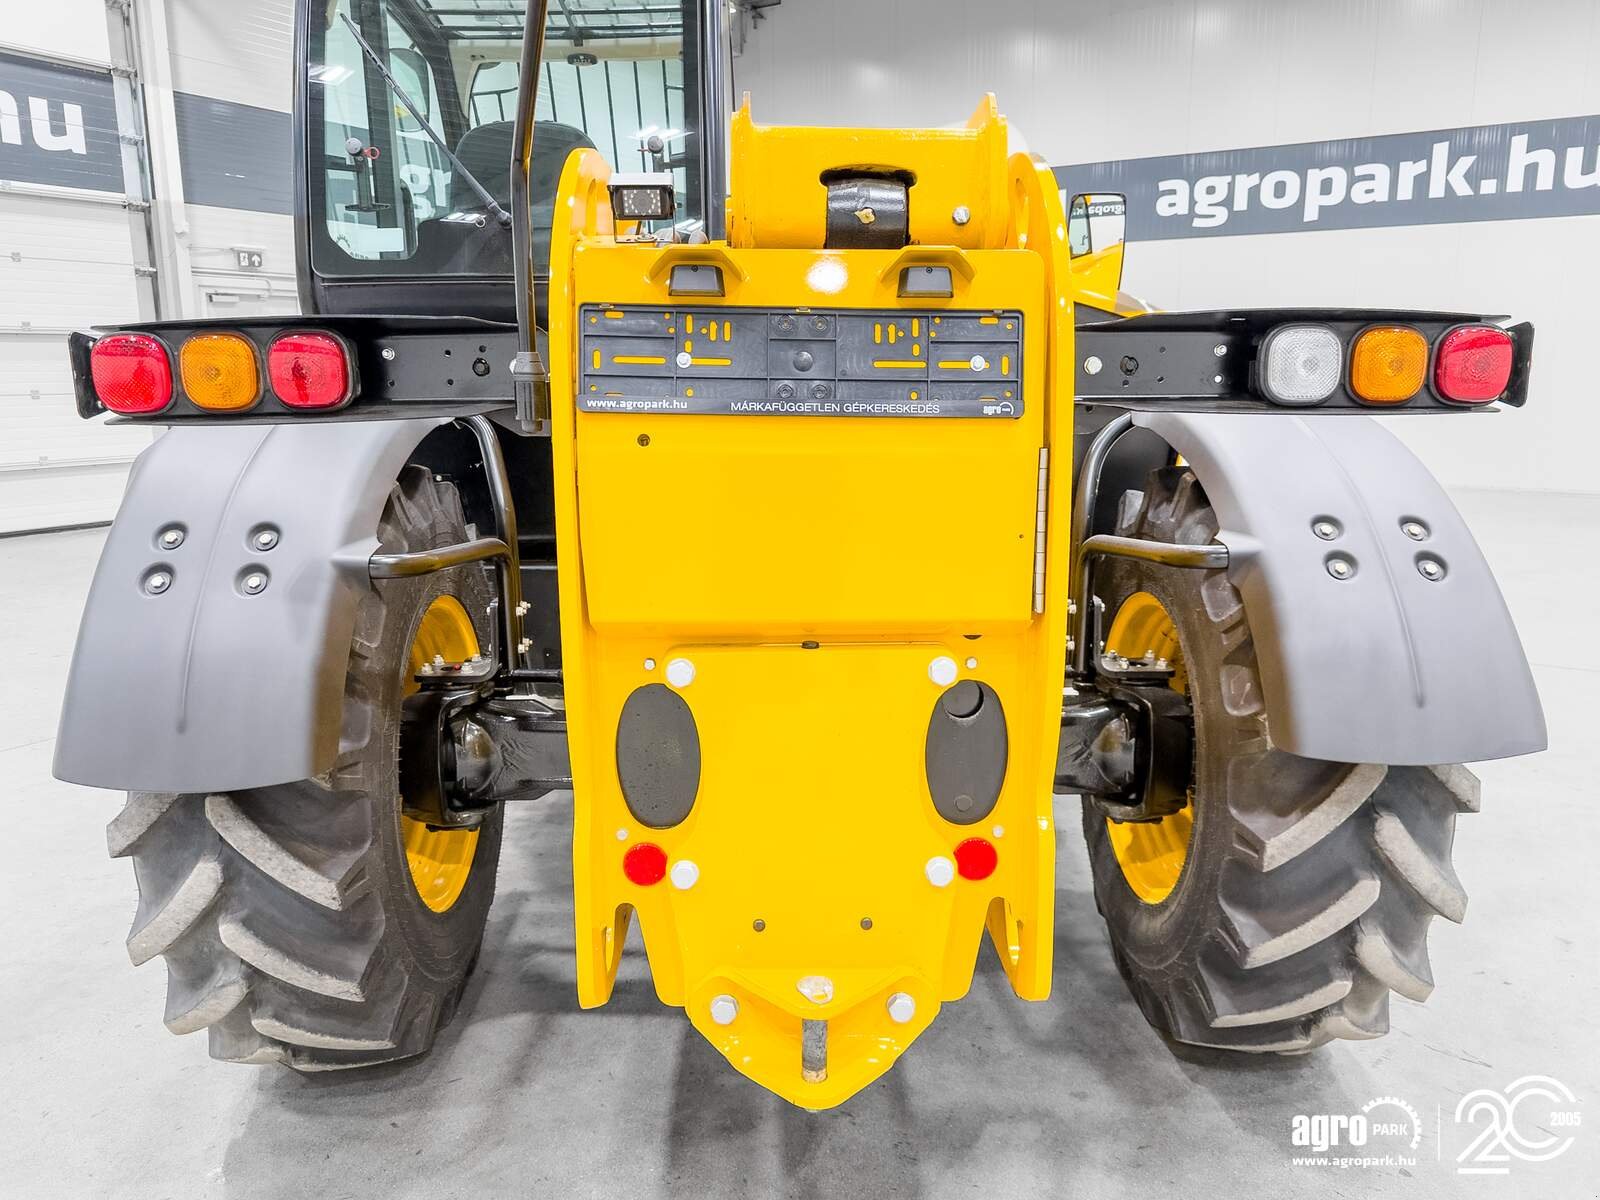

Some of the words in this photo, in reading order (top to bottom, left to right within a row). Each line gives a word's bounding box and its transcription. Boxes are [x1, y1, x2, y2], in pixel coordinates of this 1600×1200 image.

[1155, 133, 1600, 228] agropark.hu
[586, 399, 688, 410] www.agropark.hu
[730, 401, 840, 413] MÁRKAFÜGGETLEN
[843, 402, 940, 414] GÉPKERESKEDÉS
